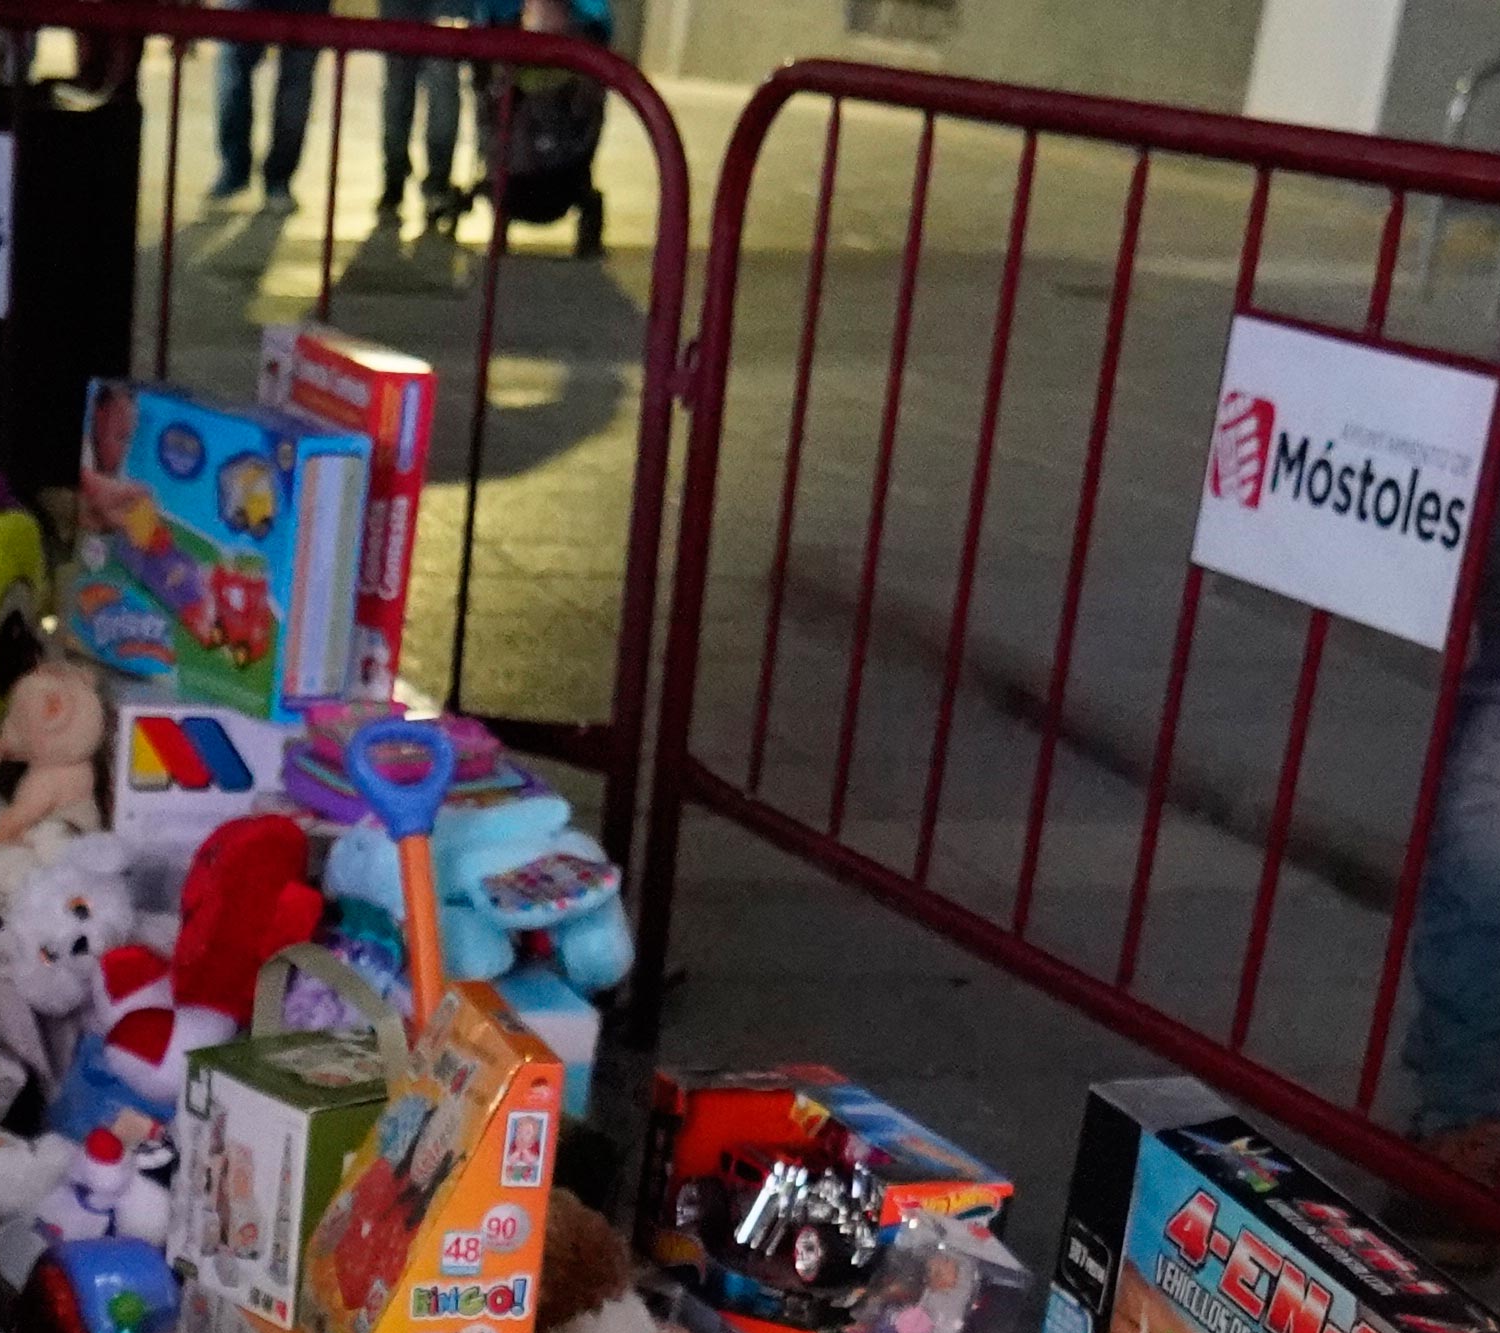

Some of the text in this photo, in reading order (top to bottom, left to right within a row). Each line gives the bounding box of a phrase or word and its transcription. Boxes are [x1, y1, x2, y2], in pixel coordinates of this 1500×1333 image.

[1271, 432, 1466, 550] Móstoles
[486, 1216, 517, 1241] 90
[444, 1236, 481, 1264] 48
